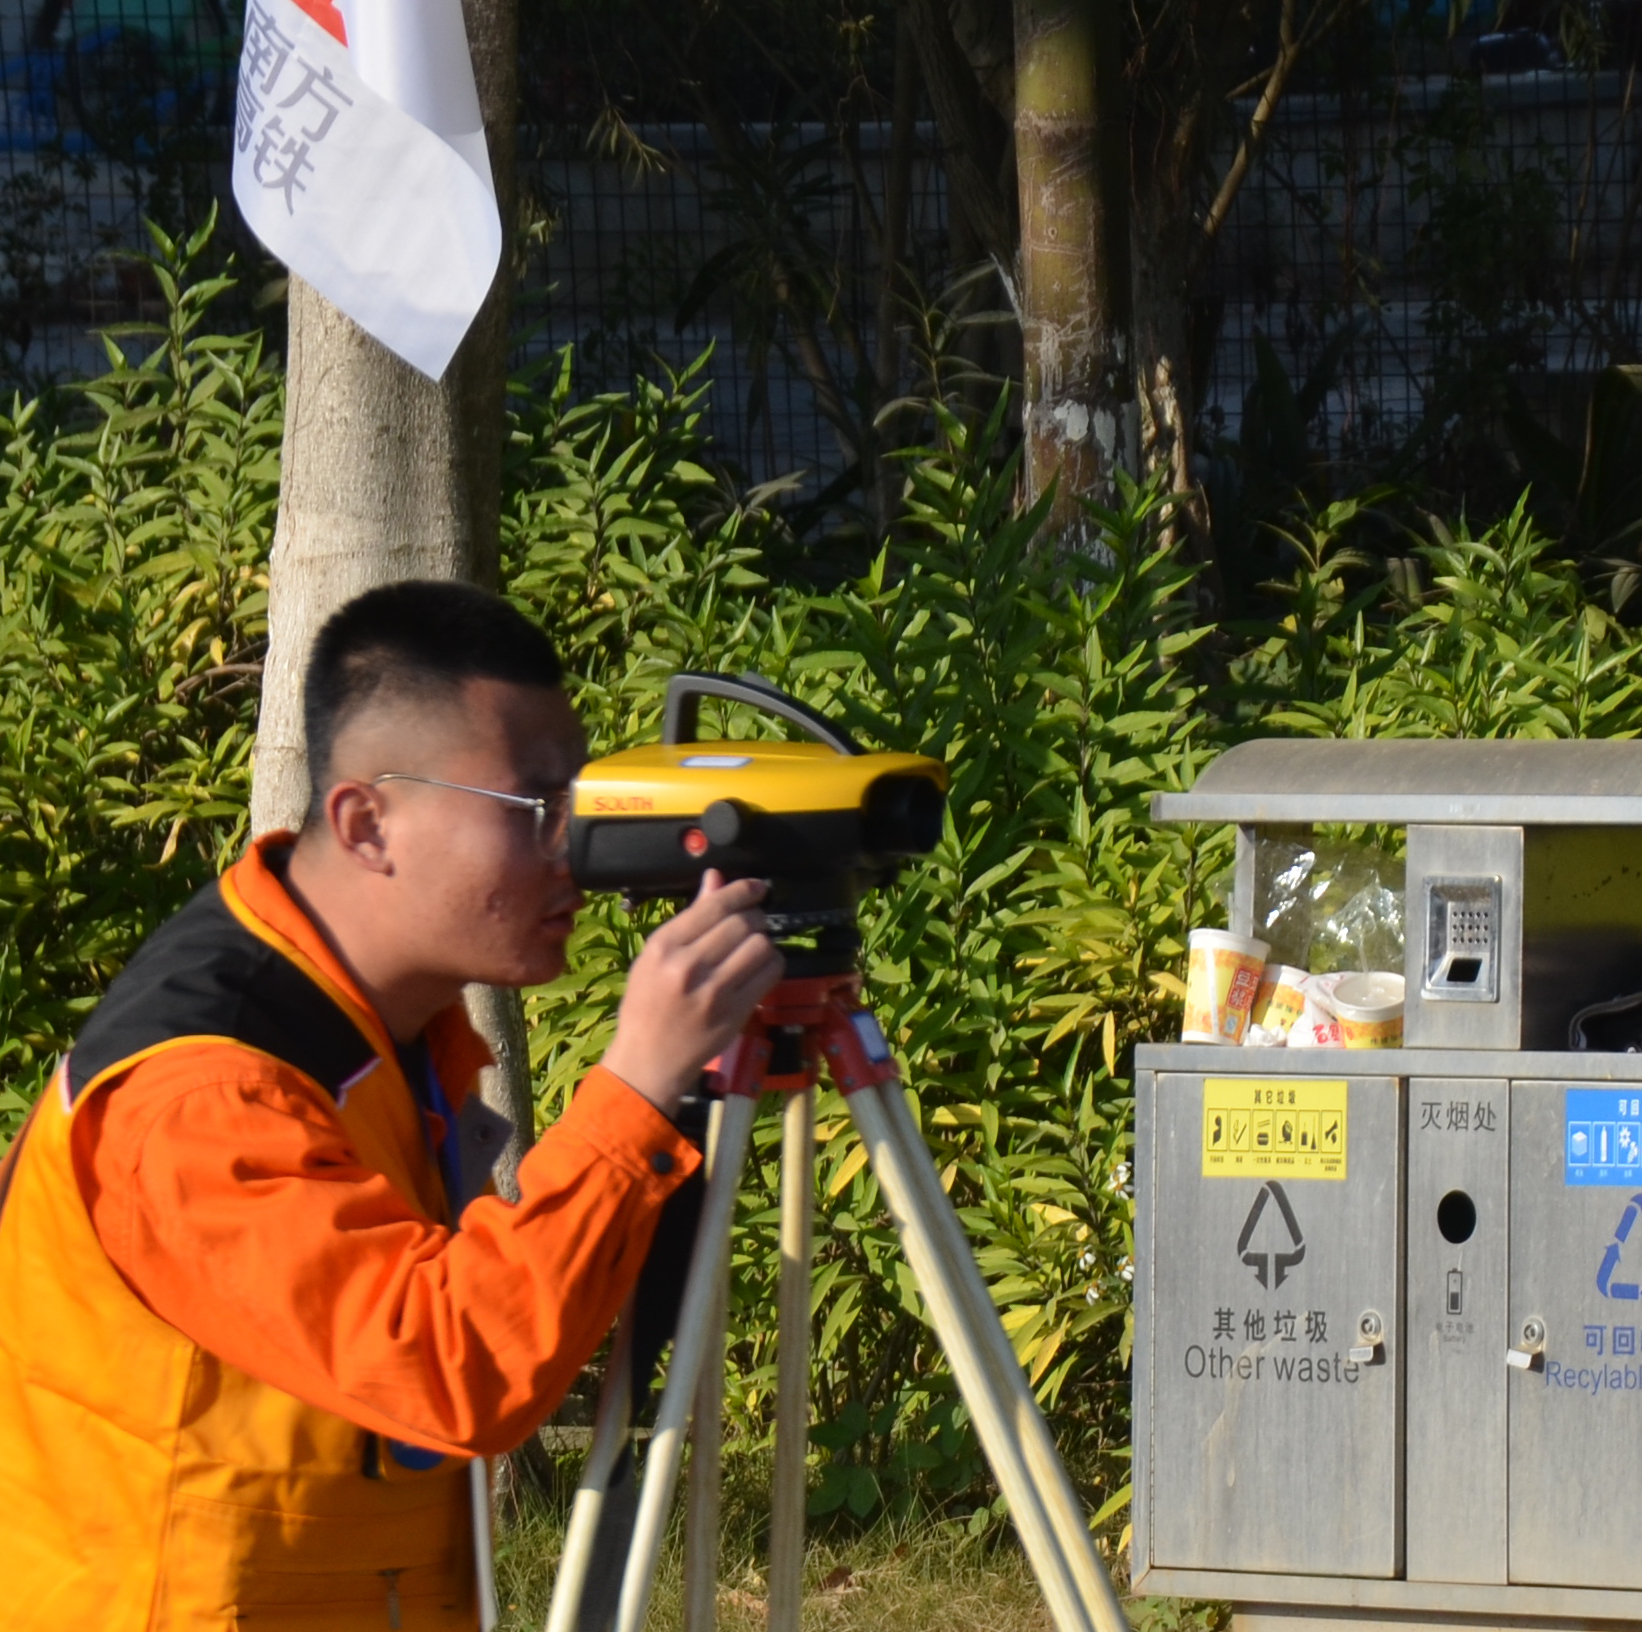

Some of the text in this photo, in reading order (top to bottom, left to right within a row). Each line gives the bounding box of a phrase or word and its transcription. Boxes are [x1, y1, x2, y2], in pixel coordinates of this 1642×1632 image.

[244, 0, 354, 143] 南方
[592, 796, 654, 811] SOUTH
[1420, 1101, 1497, 1132] 灭烟处
[1213, 1307, 1328, 1344] 其他垃圾
[1185, 1345, 1360, 1384] Other waste
